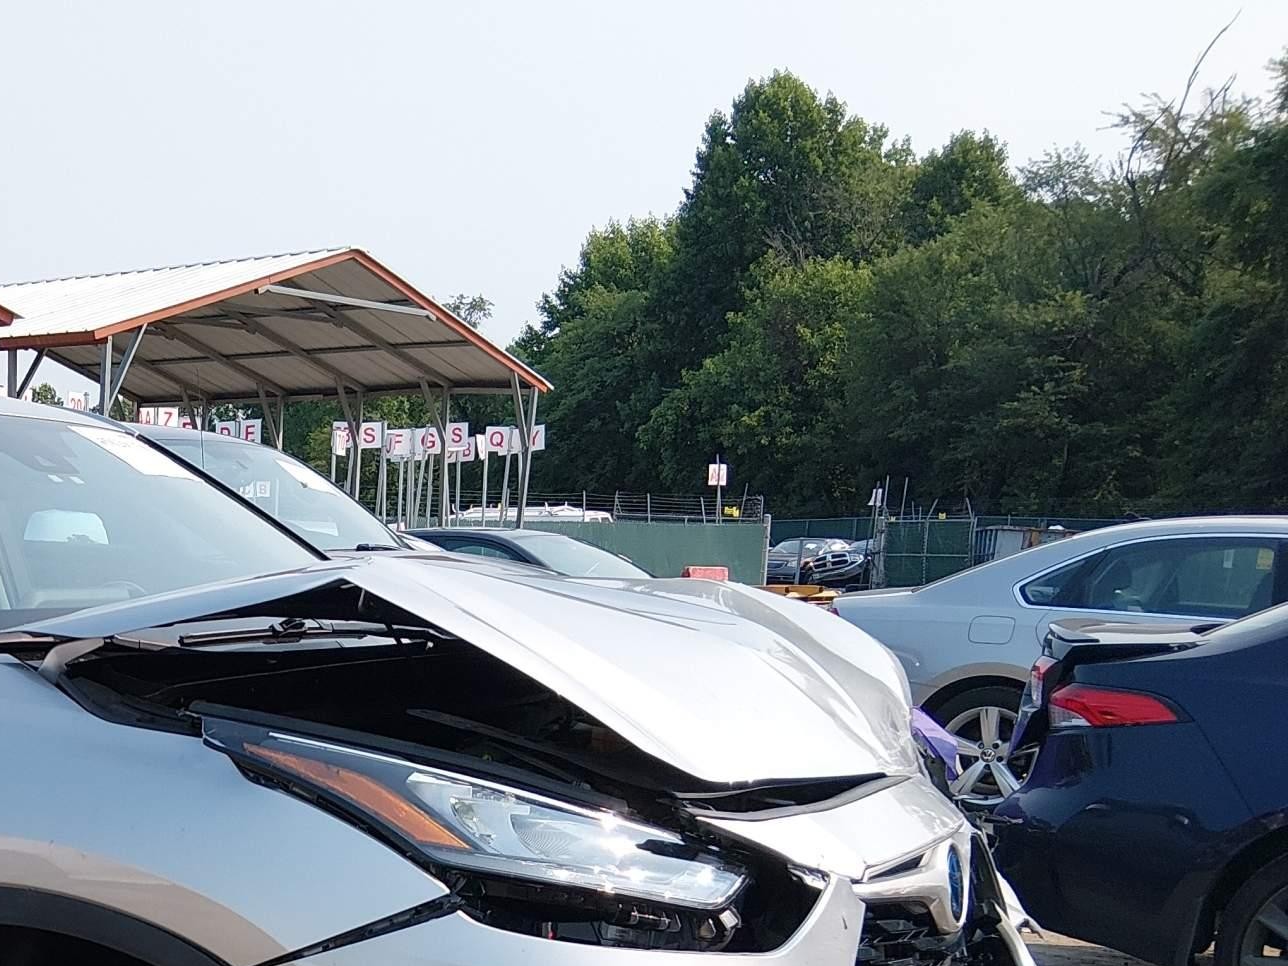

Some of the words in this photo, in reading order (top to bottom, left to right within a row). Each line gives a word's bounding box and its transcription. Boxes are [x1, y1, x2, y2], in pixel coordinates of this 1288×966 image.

[245, 424, 256, 442] E
[363, 427, 376, 444] S
[420, 432, 436, 449] G
[451, 427, 463, 444] S
[489, 430, 504, 448] Q
